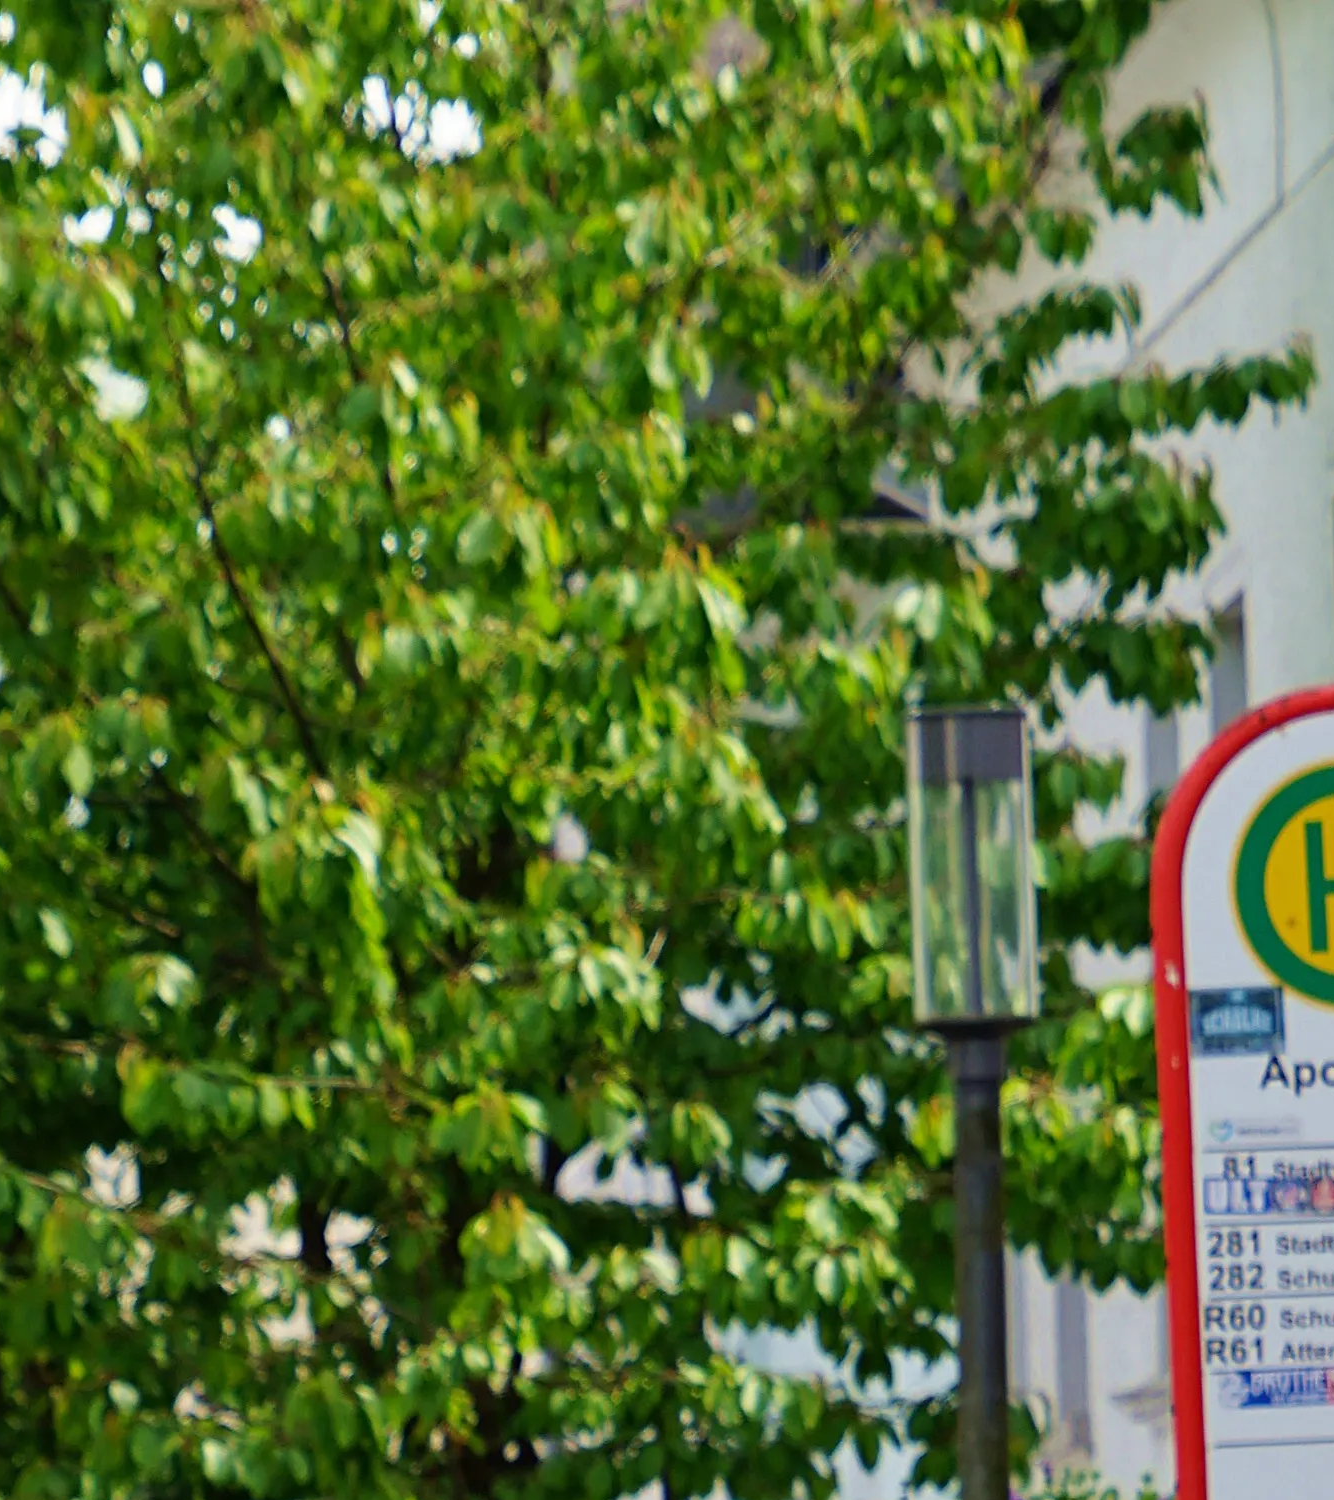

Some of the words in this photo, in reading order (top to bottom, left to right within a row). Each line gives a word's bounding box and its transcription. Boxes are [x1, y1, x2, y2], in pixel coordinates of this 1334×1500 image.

[1207, 1230, 1261, 1258] 281
[1208, 1262, 1265, 1291] 282
[1204, 1304, 1267, 1332] R60
[1205, 1337, 1265, 1365] R61
